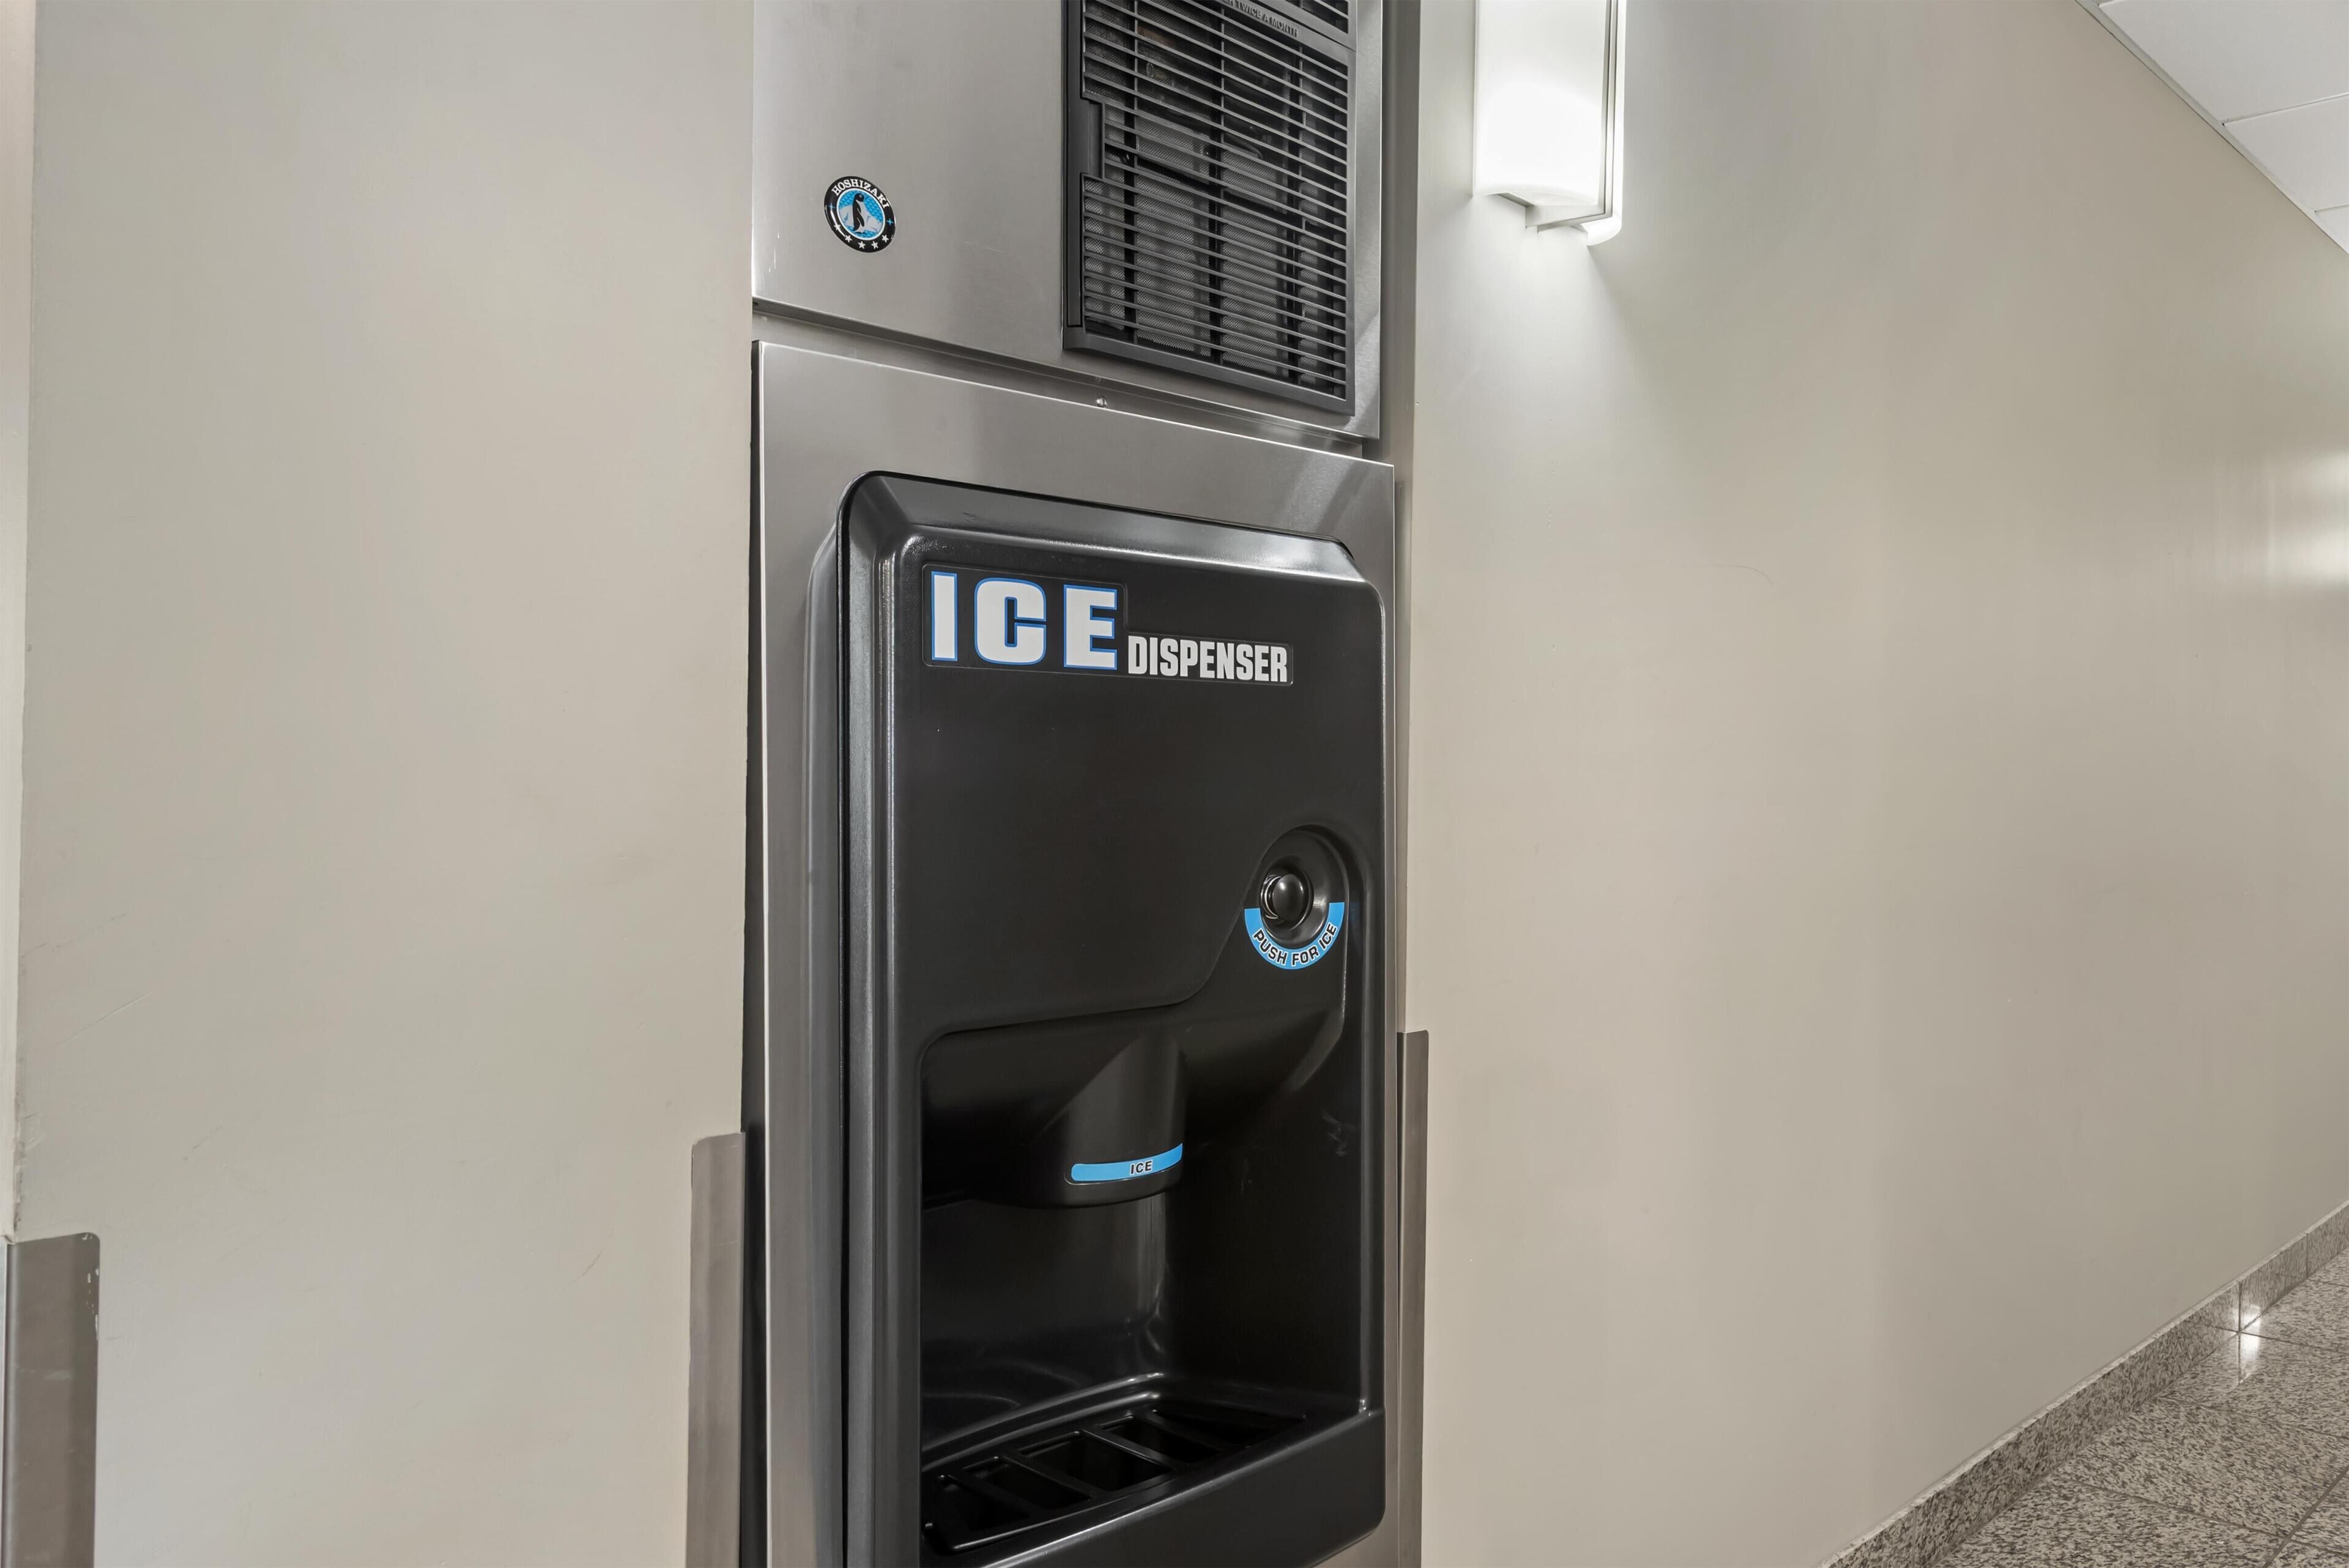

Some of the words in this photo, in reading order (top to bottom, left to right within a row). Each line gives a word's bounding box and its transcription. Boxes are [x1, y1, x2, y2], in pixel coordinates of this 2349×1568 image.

[1236, 0, 1262, 19] TWICE
[1263, 13, 1270, 24] A
[1271, 17, 1297, 37] MONTH
[831, 178, 890, 209] HOSHIZAKI
[931, 571, 1117, 671] ICE
[1127, 634, 1288, 683] DISPENSER
[1253, 928, 1288, 965] PUSH
[1291, 945, 1319, 966] FOR
[1318, 923, 1337, 949] ICE
[1130, 1160, 1152, 1175] ICE
